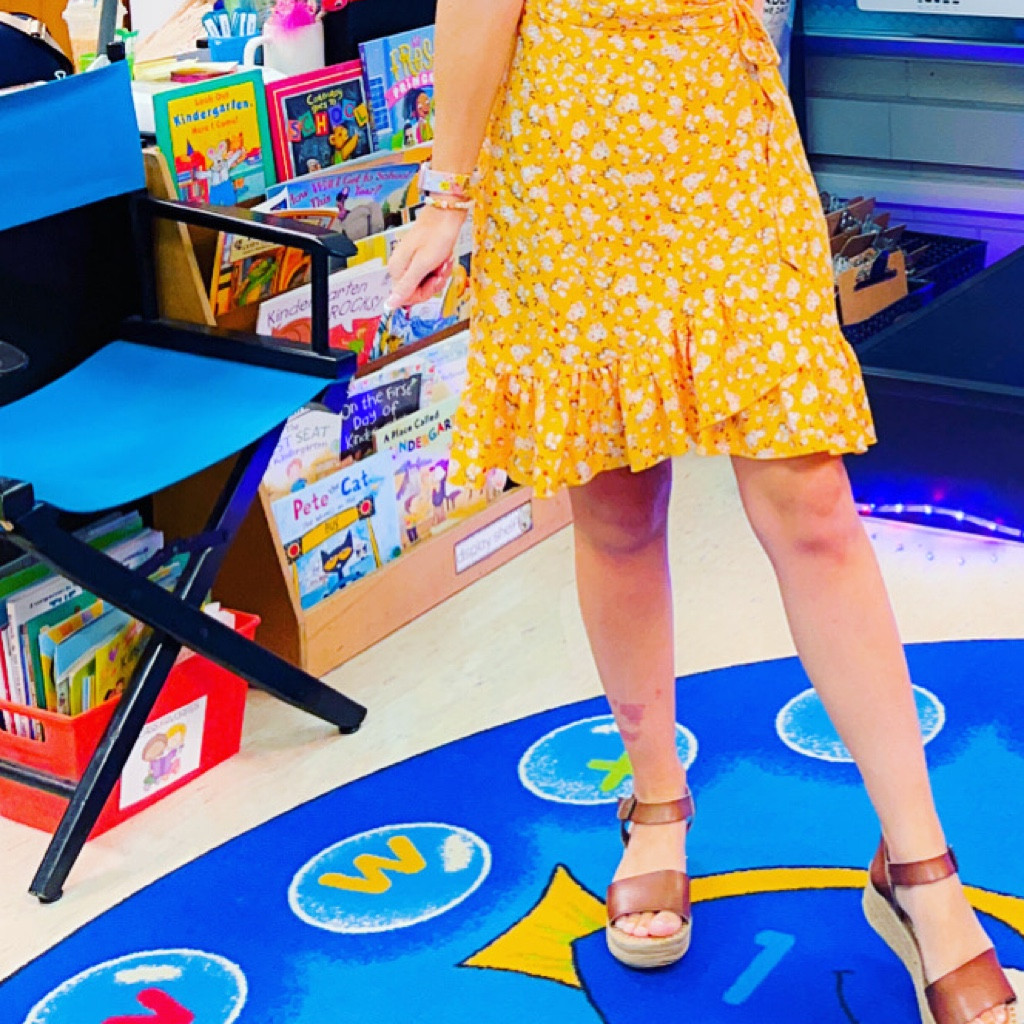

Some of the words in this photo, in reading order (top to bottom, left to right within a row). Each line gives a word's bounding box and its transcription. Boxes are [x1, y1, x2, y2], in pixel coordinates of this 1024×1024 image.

[353, 410, 378, 431] Day
[382, 400, 399, 422] of
[362, 391, 383, 410] the
[391, 425, 412, 440] Place
[415, 410, 439, 429] Called
[293, 492, 329, 521] Pete
[341, 470, 369, 496] Cat
[722, 930, 796, 1005] 1
